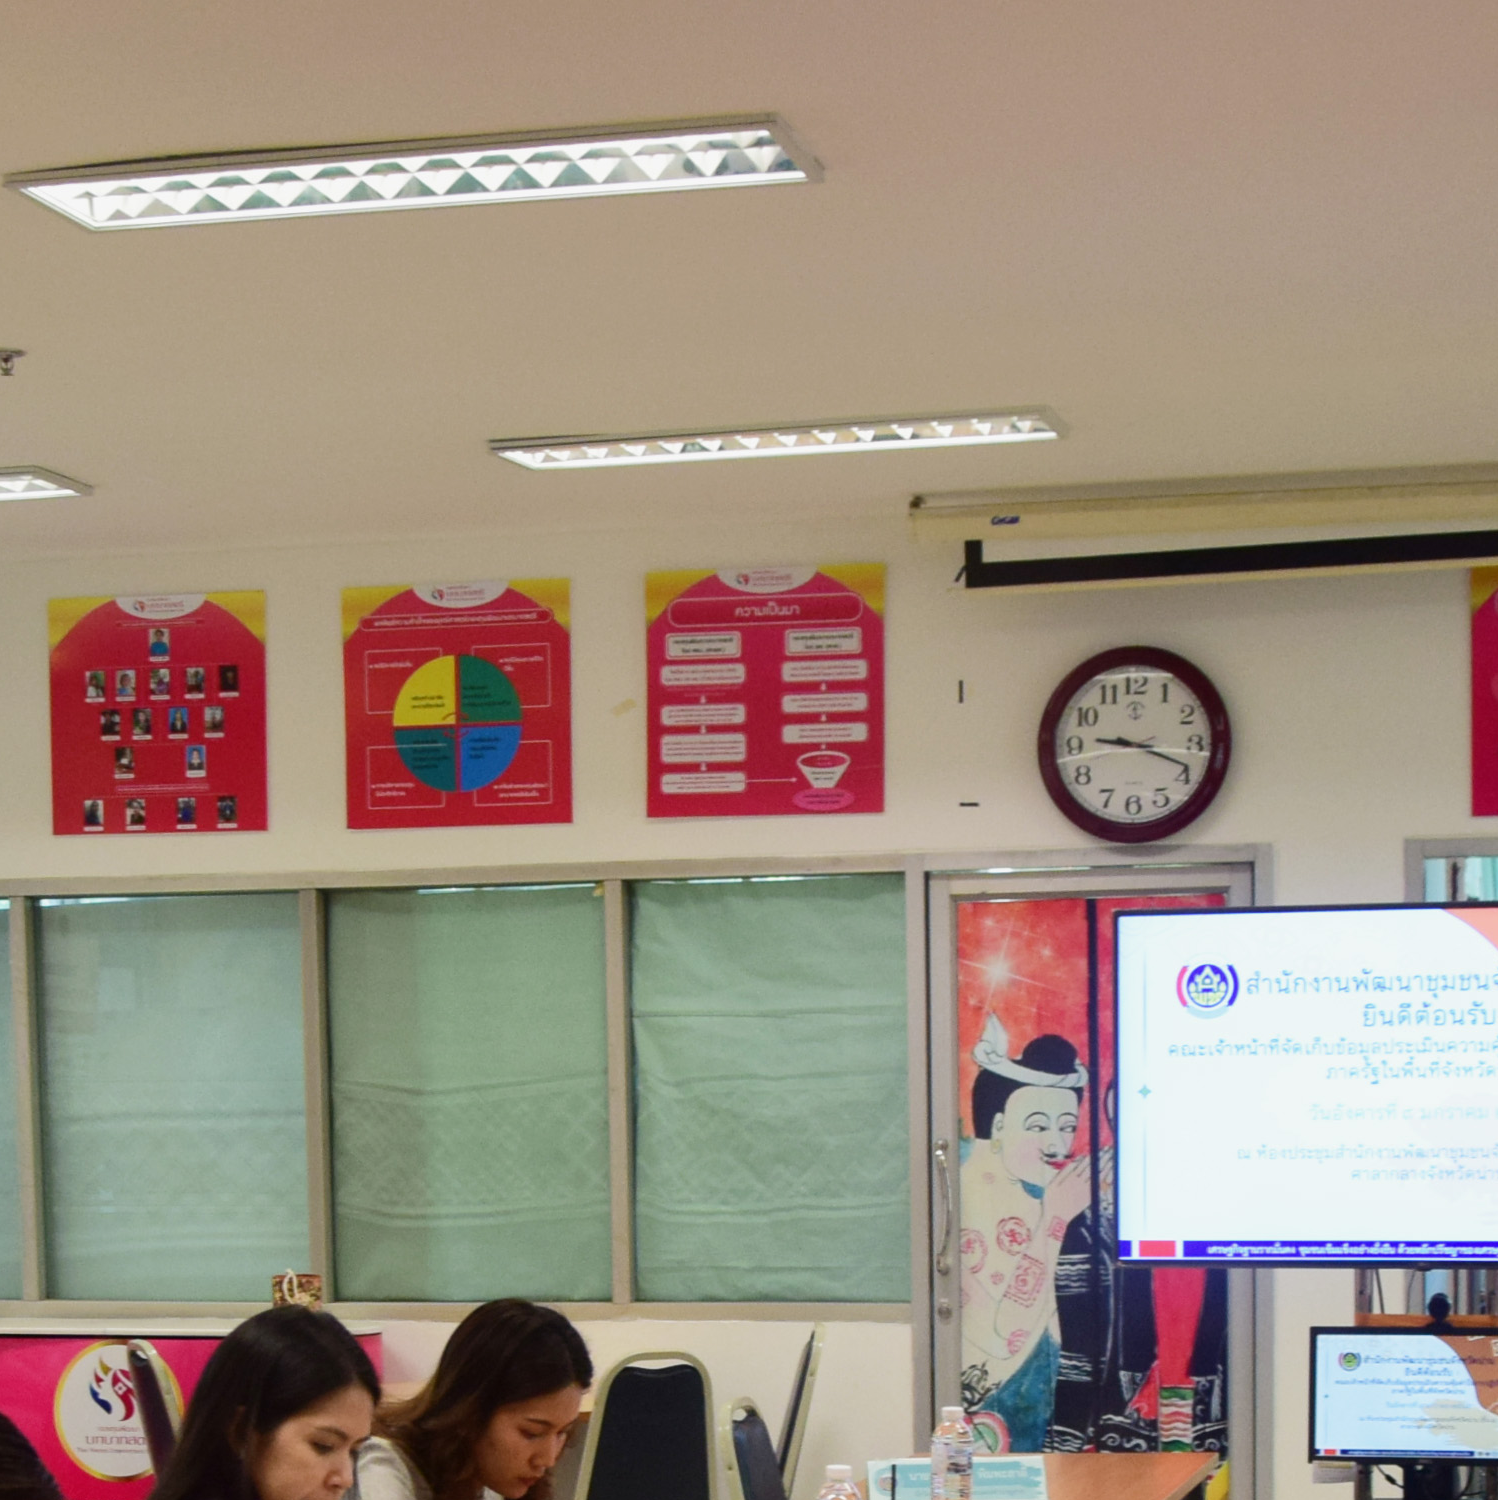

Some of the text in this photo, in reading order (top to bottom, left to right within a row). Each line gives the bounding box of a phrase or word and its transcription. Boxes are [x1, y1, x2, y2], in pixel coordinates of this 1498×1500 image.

[734, 600, 801, 617] ความเป็นมา
[1099, 684, 1119, 705] 11
[1123, 676, 1149, 695] 12
[1160, 683, 1170, 703] 1
[1077, 706, 1099, 727] 10
[1180, 704, 1195, 725] 2
[1066, 735, 1083, 756] 9
[1187, 735, 1204, 752] 3
[1074, 765, 1092, 786] 8
[1174, 764, 1191, 785] 4
[1099, 788, 1115, 809] 7
[1125, 795, 1142, 816] 6
[1152, 788, 1170, 808] 5
[1362, 1001, 1497, 1027] ยินดีต้อนรับ
[85, 1435, 147, 1446] บทบาทสต
